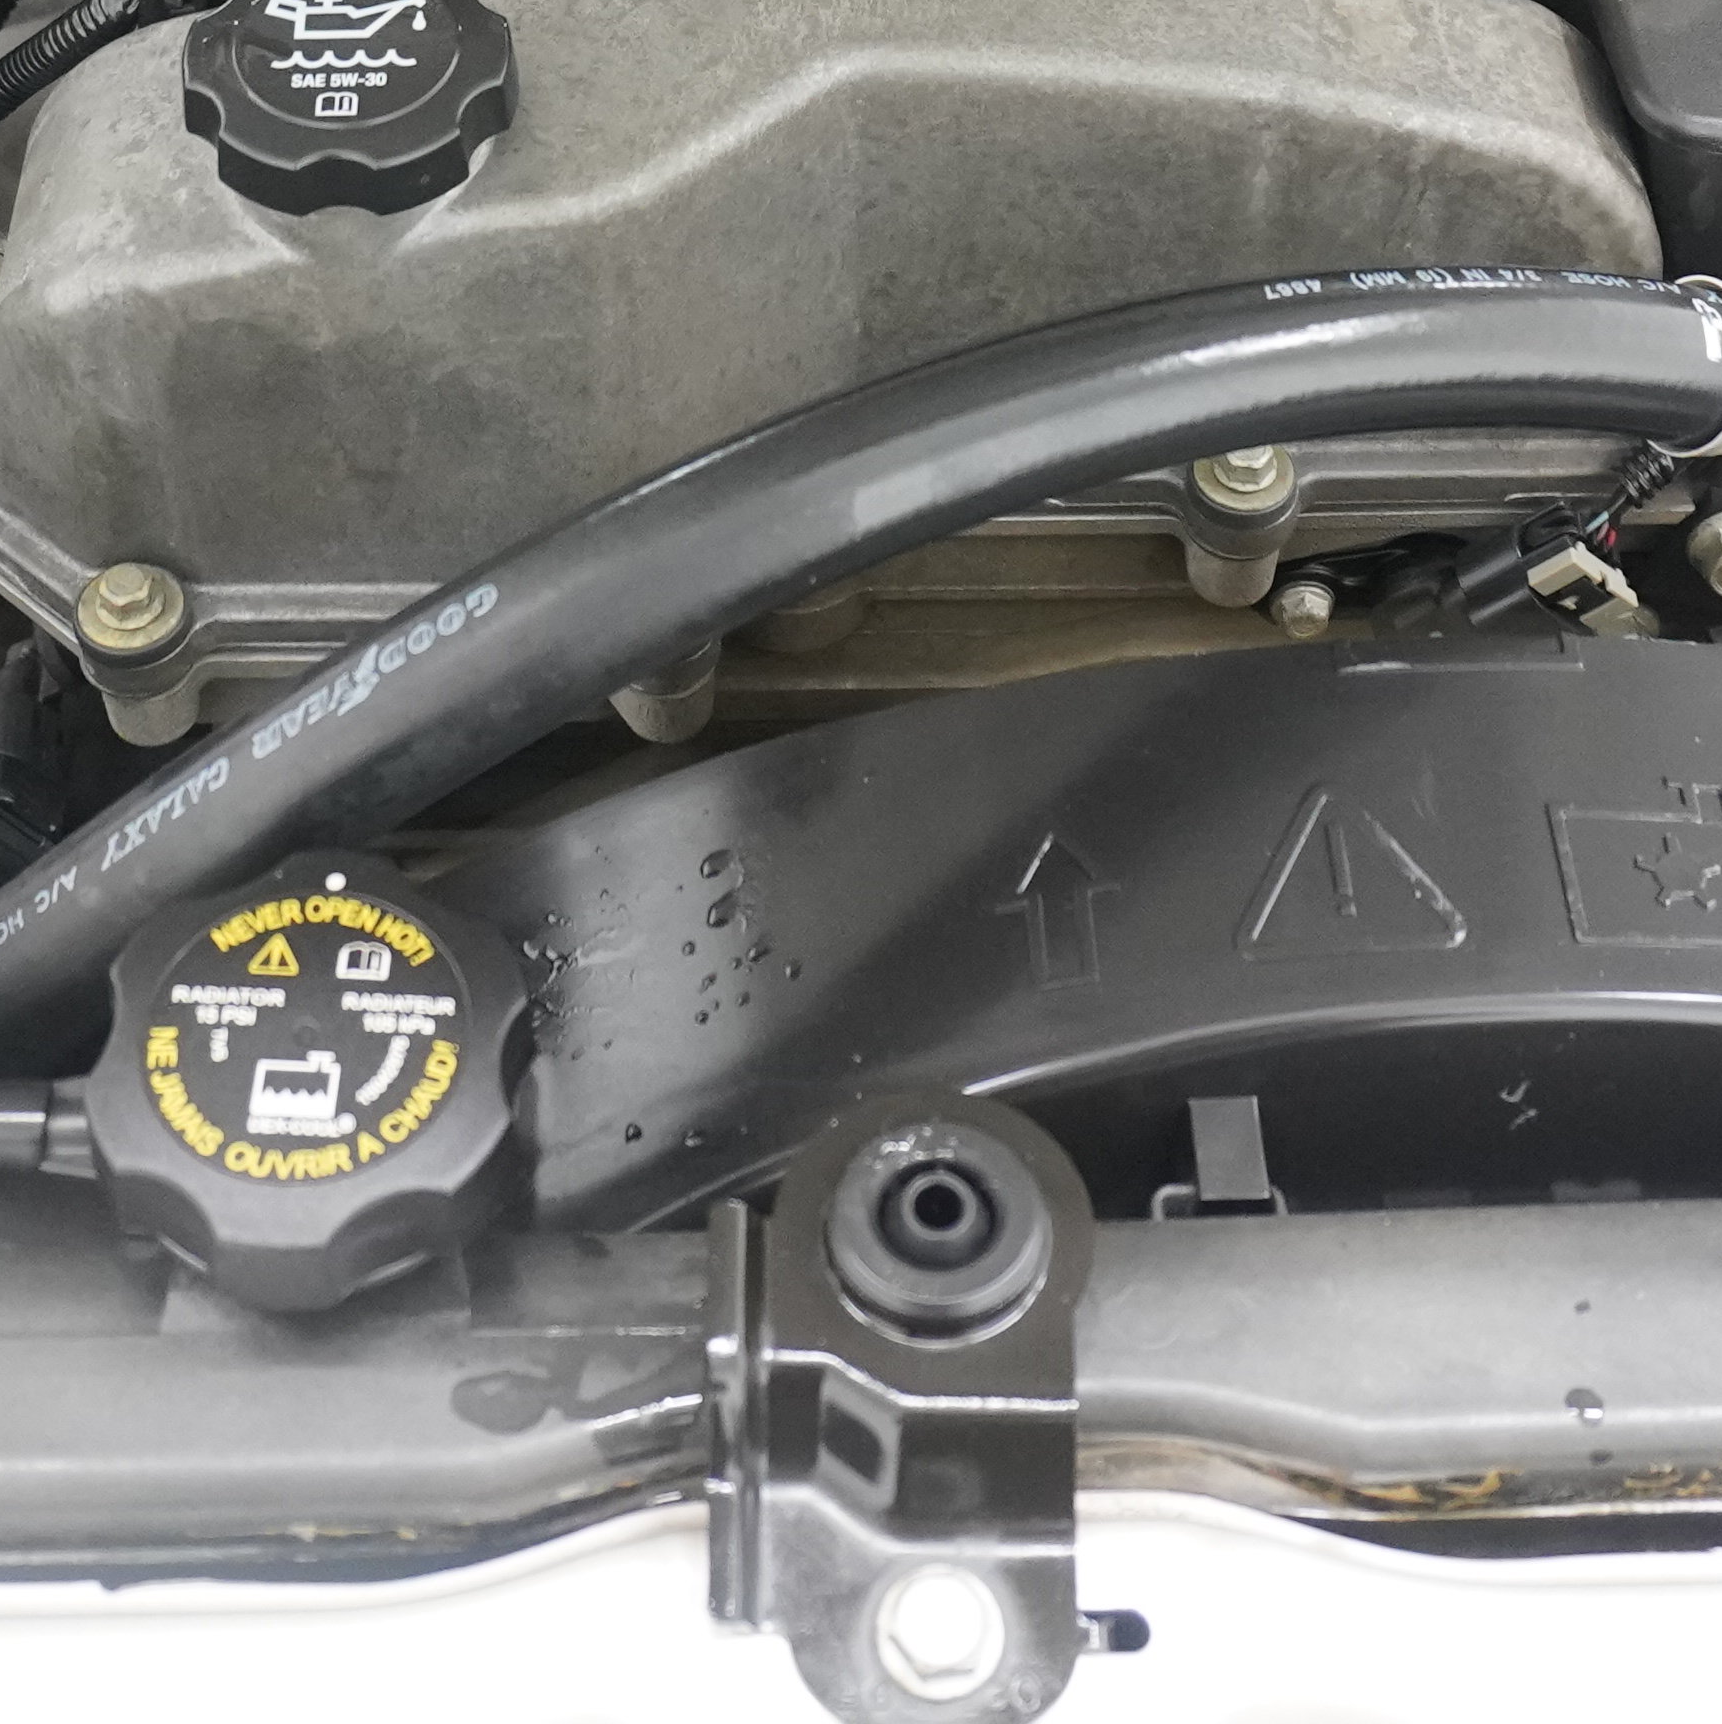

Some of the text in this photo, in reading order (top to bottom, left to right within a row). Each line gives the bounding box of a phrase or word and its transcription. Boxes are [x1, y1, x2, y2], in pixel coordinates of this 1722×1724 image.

[291, 72, 388, 89] SAE 5W-30
[1459, 268, 1491, 285] IN
[252, 583, 499, 760] GOODYEAR
[100, 756, 230, 872] GALAXY
[33, 864, 77, 914] A/C
[209, 897, 305, 954] NEVER
[304, 894, 382, 934] OPEN
[171, 983, 286, 1007] RADIATOR
[341, 990, 457, 1017] RADIATEUR
[147, 1025, 179, 1070] NE
[147, 1066, 226, 1158] JAMAIS
[223, 1139, 354, 1181] OUVRIR
[355, 1131, 387, 1164] A
